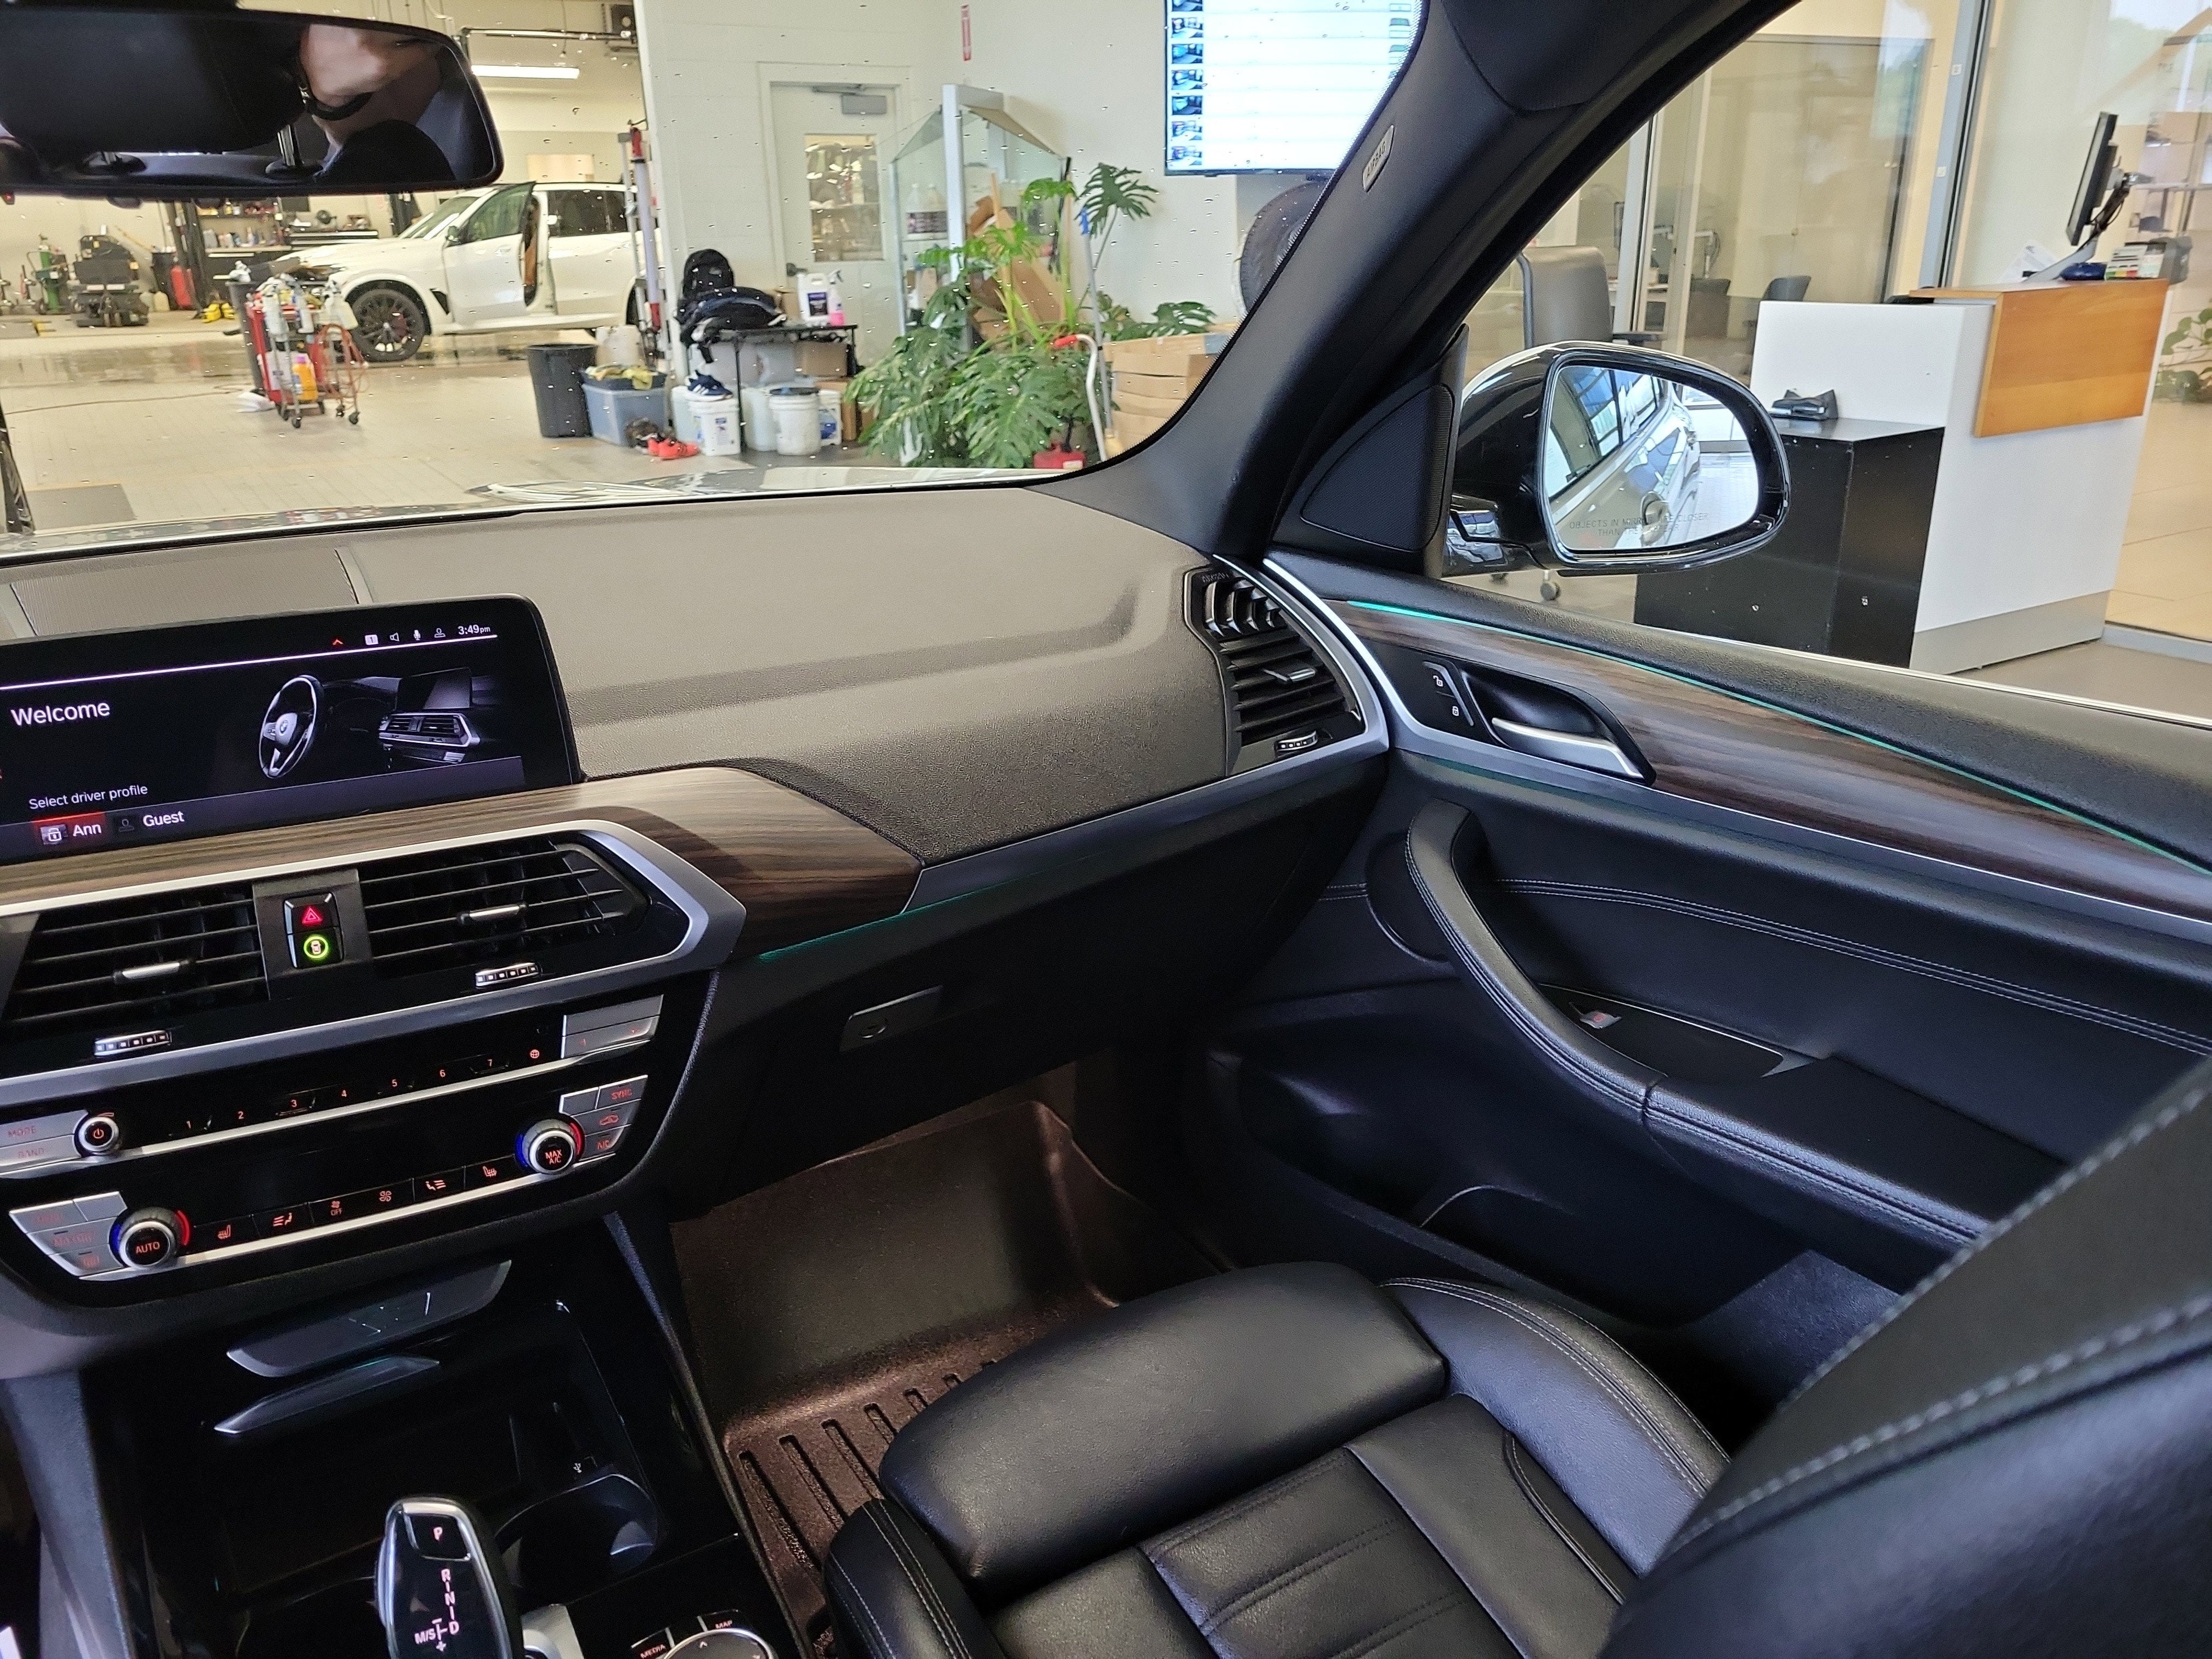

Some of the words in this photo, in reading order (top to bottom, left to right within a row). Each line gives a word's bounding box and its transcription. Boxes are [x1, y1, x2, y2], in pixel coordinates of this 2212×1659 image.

[1366, 140, 1386, 180] AIRBAG
[1570, 520, 1607, 529] OBJECTS
[1610, 518, 1619, 527] IN
[1622, 516, 1654, 526] MIRRR
[458, 624, 491, 635] 3:49pm
[10, 702, 110, 726] Welcome
[29, 795, 69, 809] Select
[71, 790, 105, 804] driver
[109, 785, 148, 802] profile
[72, 823, 101, 837] Ann
[143, 810, 185, 827] Guest
[186, 1120, 191, 1128] 1
[238, 1111, 244, 1120] 2
[291, 1099, 297, 1108] 3
[439, 1069, 446, 1077] 6
[611, 1088, 633, 1099] SYNC
[7, 1125, 37, 1137] MODE
[545, 1149, 562, 1159] MAX
[549, 1156, 562, 1165] A/C
[136, 1242, 160, 1254] AUTO
[433, 1527, 443, 1541] P
[441, 1568, 450, 1582] R
[444, 1591, 455, 1606] N
[715, 1620, 733, 1629] MAP
[414, 1628, 436, 1644] M/S
[449, 1621, 459, 1635] D
[640, 1644, 666, 1659] MEDIA
